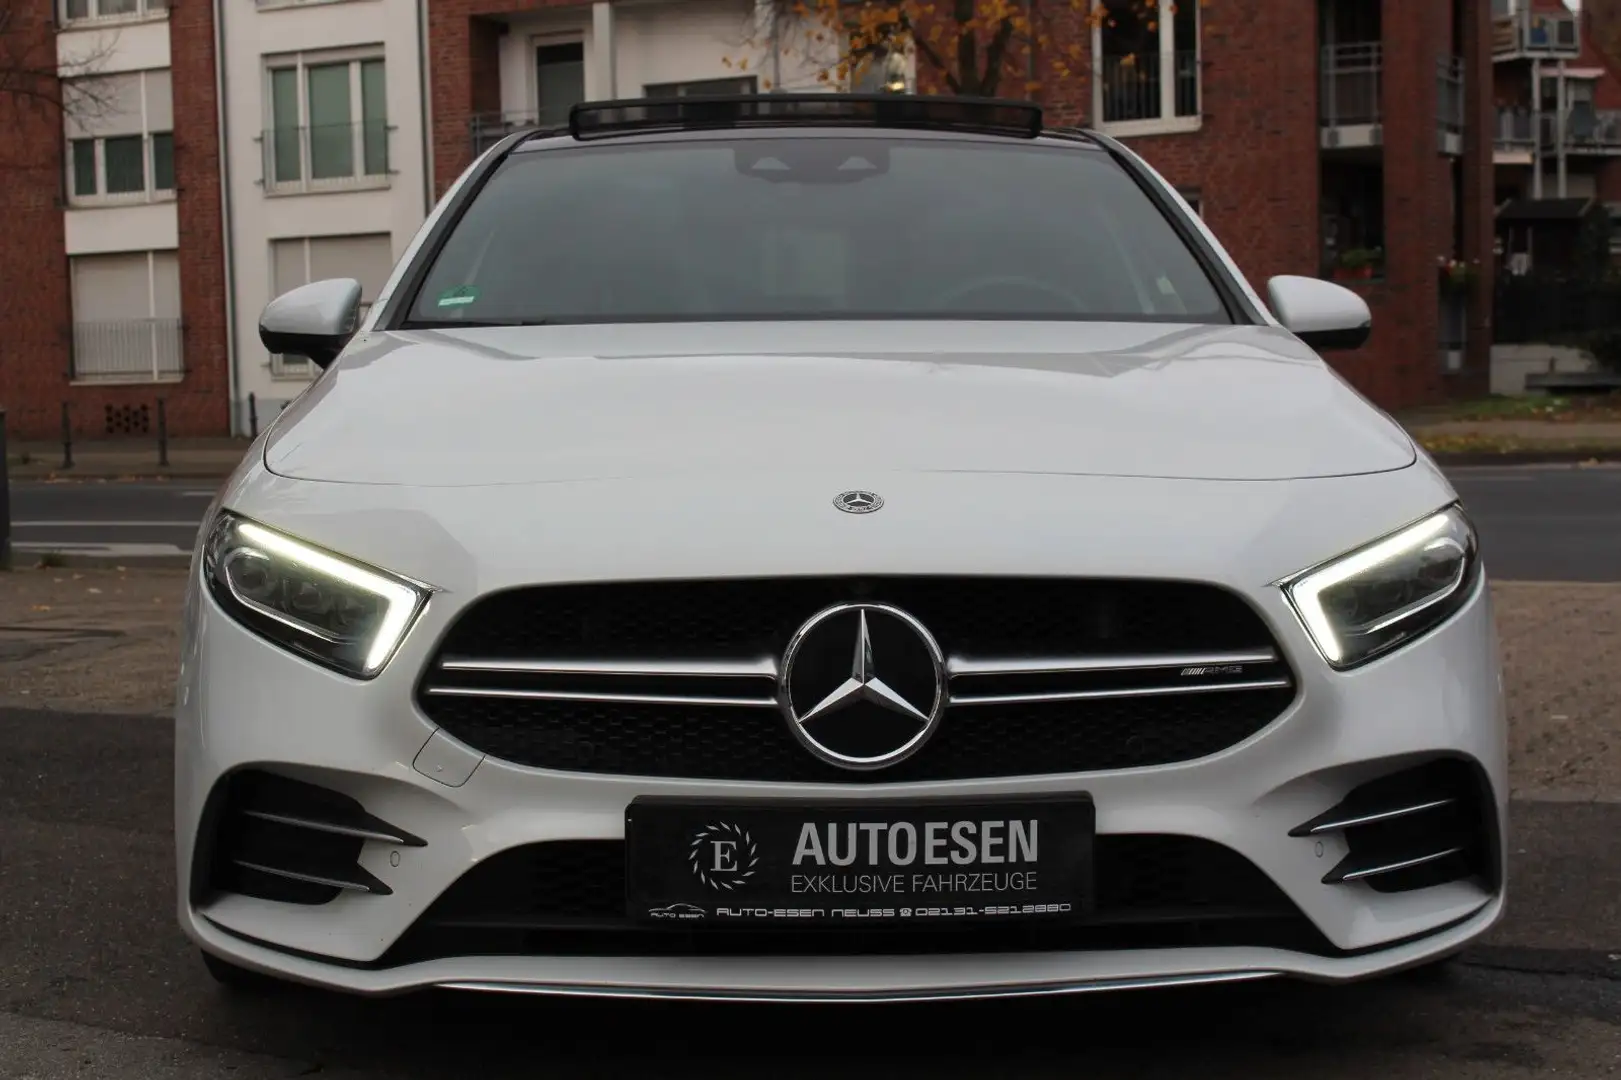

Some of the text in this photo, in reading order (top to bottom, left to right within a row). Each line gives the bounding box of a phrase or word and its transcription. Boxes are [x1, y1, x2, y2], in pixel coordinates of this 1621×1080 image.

[709, 840, 738, 872] E
[791, 871, 1038, 893] EXKLUSIVE FAHRZEUGE
[716, 903, 1072, 918] AUTO-ESEN NEUSS 02131-5212880
